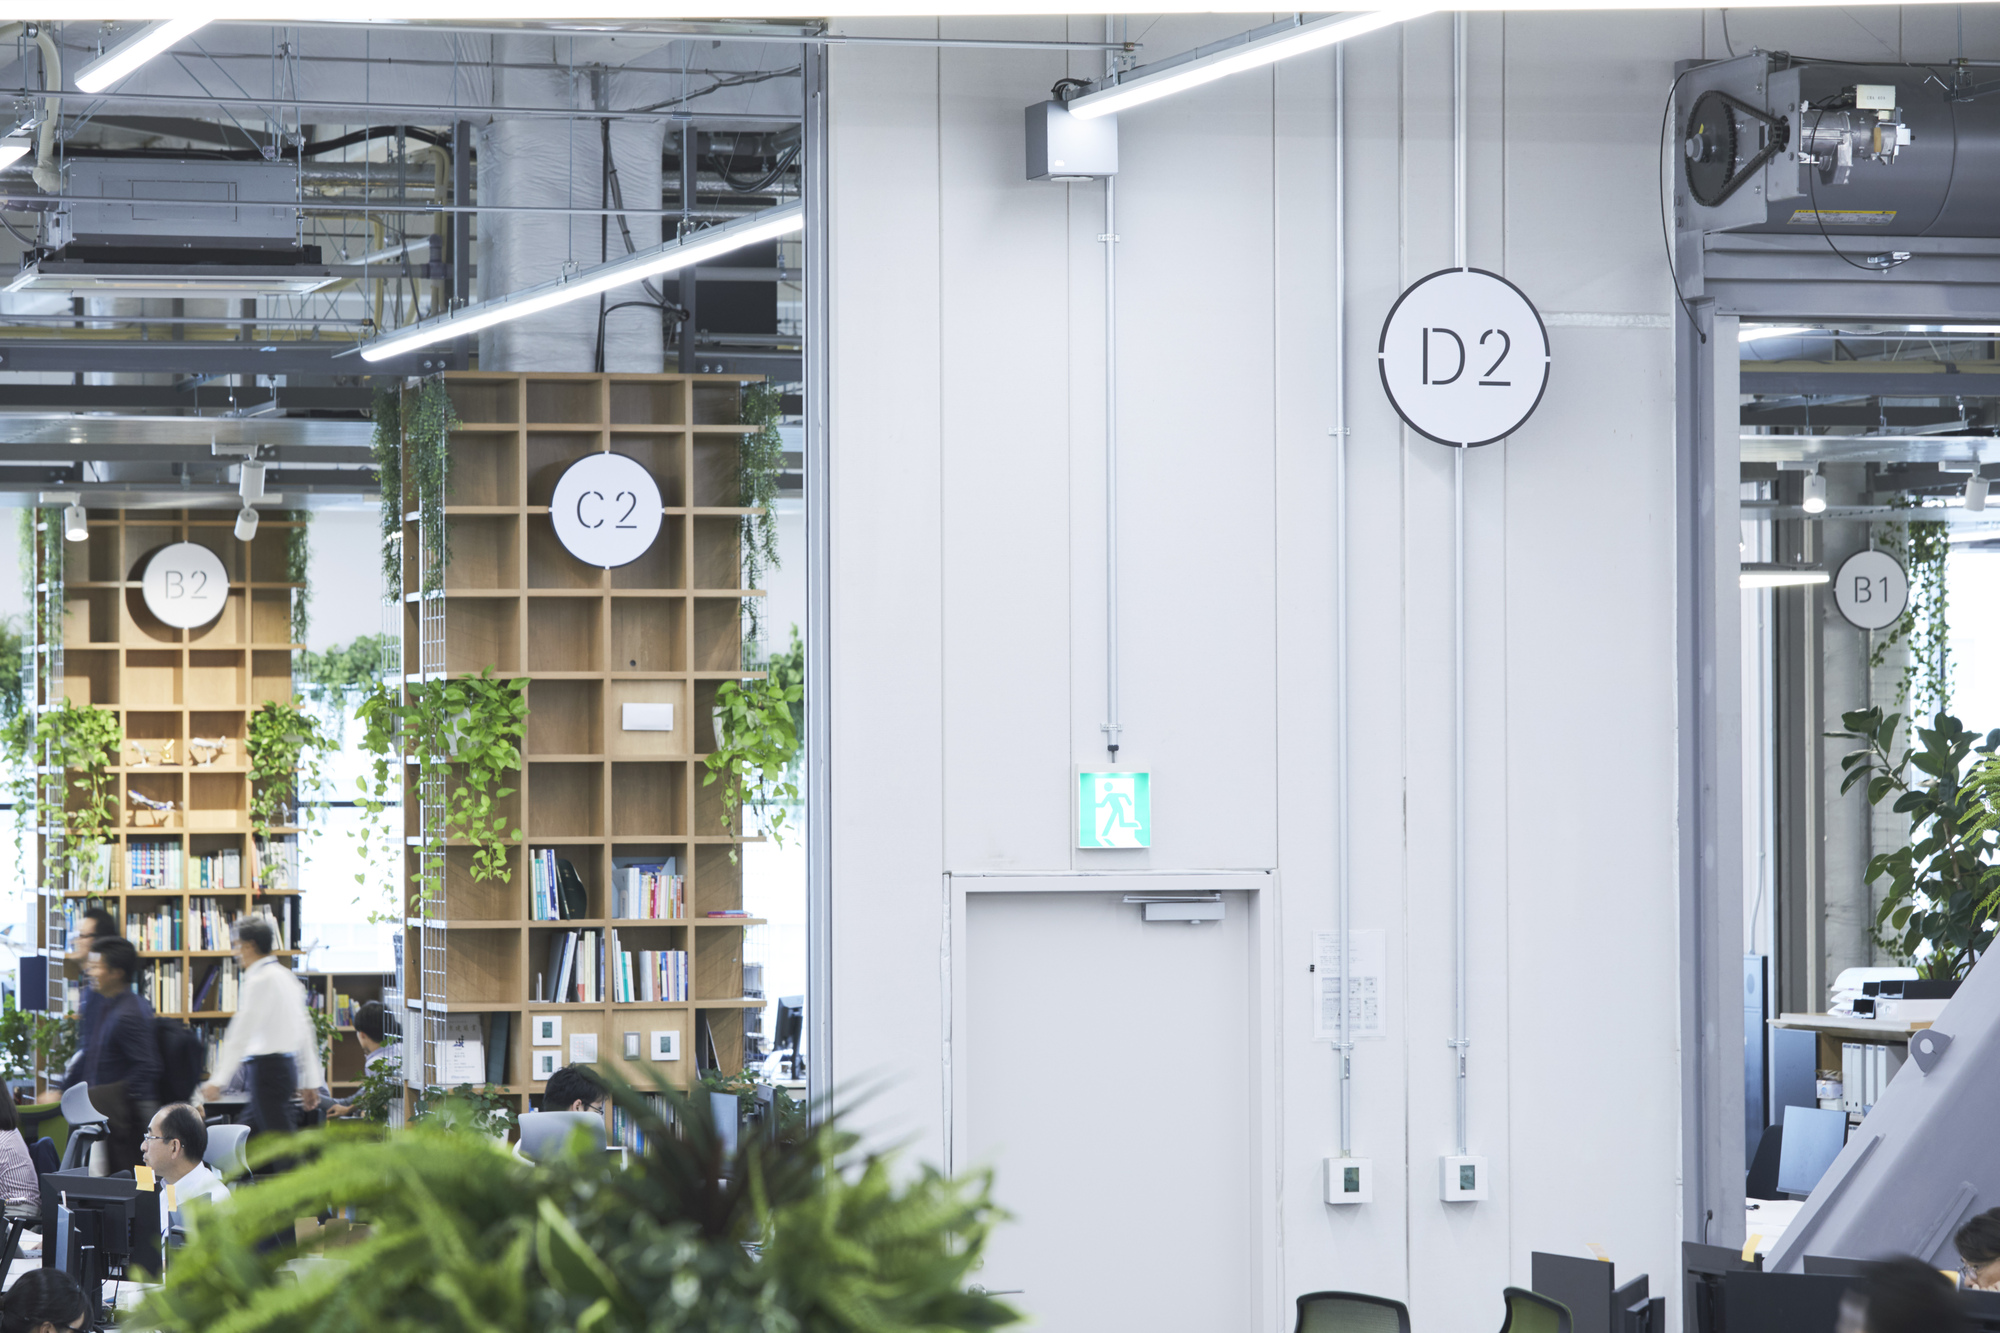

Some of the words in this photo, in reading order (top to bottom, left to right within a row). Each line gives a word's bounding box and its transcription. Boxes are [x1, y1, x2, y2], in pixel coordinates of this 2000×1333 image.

[1422, 327, 1511, 387] D2
[576, 491, 638, 529] C2
[165, 570, 208, 599] B2
[1854, 576, 1888, 603] B1
